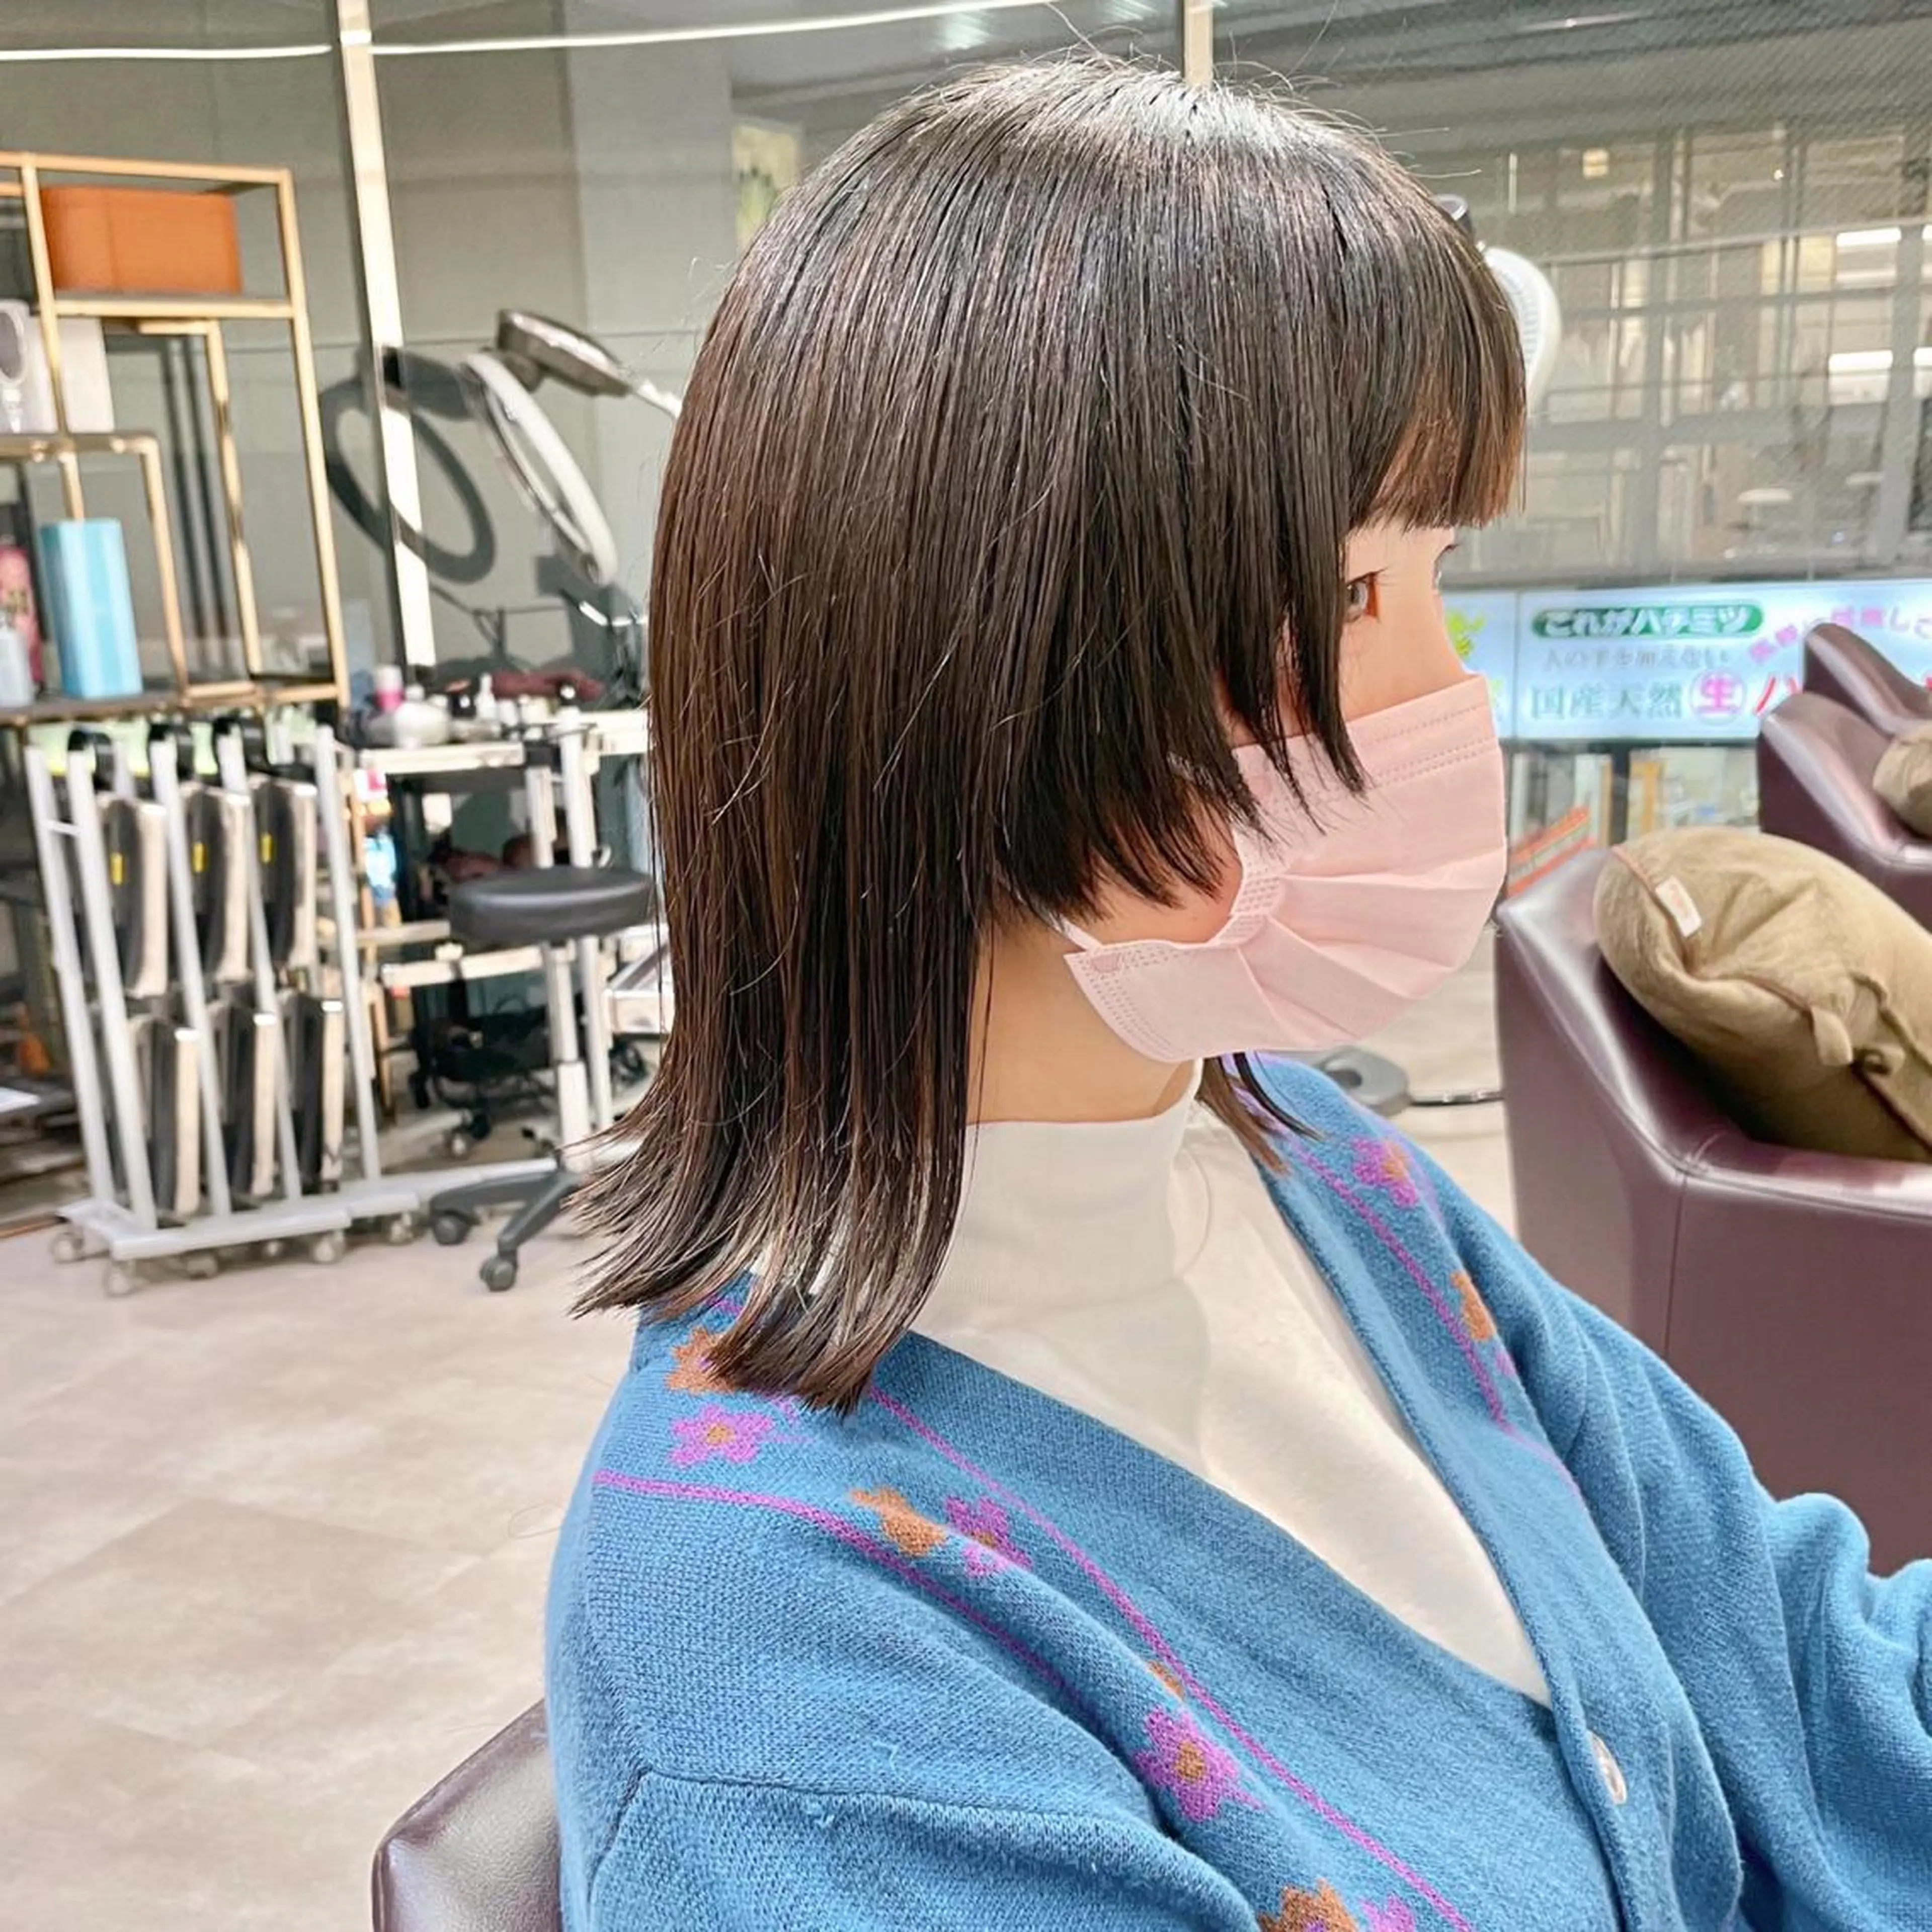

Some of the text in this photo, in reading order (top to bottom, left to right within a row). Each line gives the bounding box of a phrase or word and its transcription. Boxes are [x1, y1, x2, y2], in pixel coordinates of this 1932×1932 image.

[1545, 605, 1749, 636] これがハチミツ
